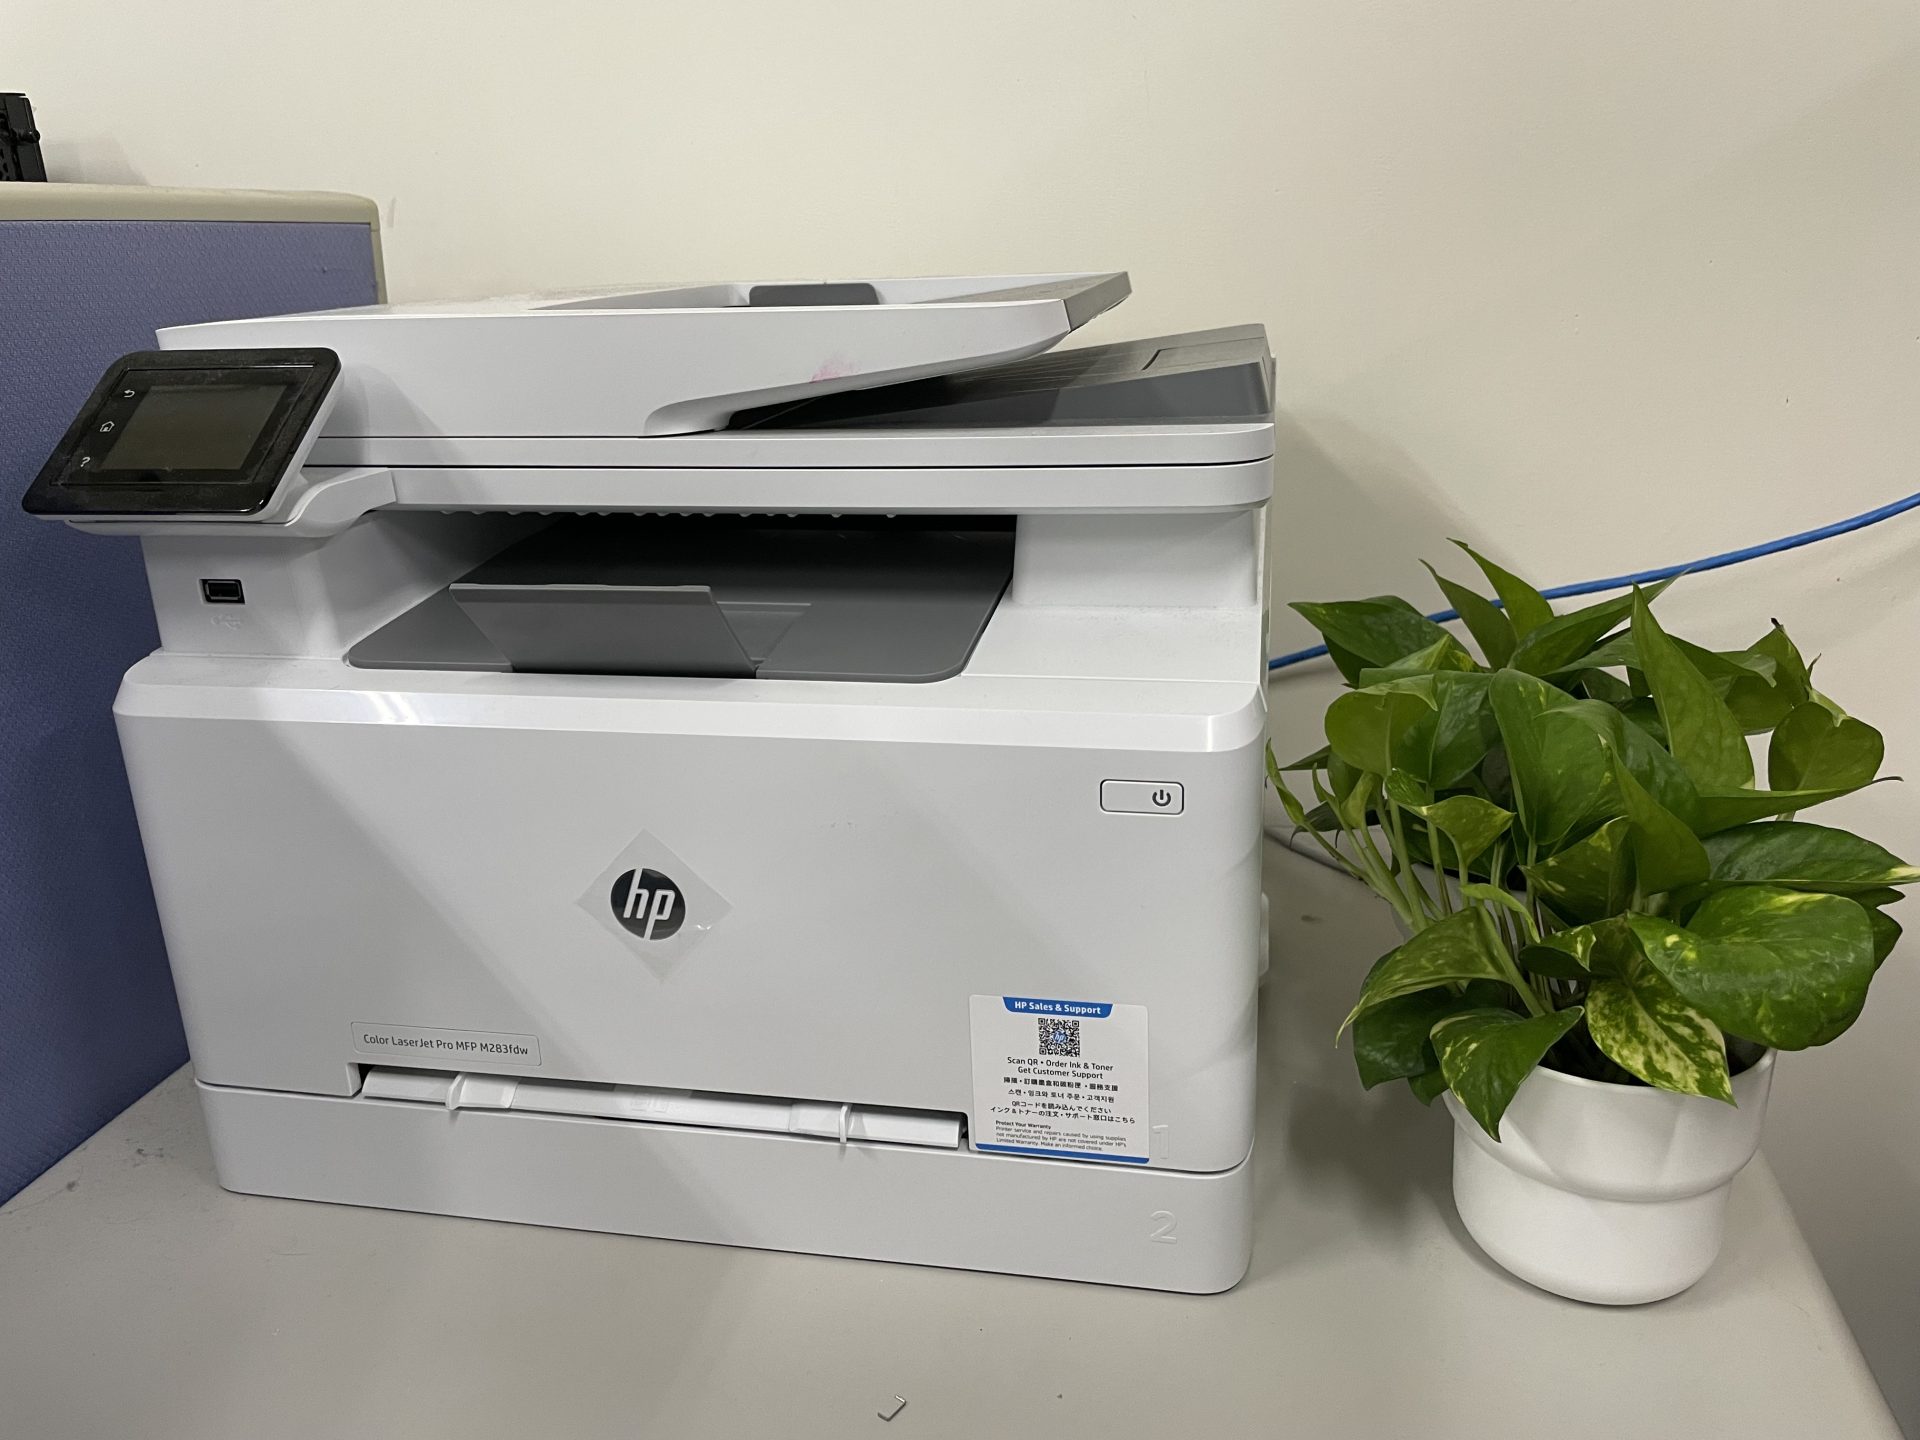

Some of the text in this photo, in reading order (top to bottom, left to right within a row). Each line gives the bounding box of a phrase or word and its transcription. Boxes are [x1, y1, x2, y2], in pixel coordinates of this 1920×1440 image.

[620, 868, 677, 939] hp
[1014, 1001, 1027, 1009] HP
[1029, 1002, 1053, 1011] Sales
[1064, 1004, 1101, 1014] Support
[363, 1034, 529, 1055] Color LaserJet Pro MFP M283fdw
[1007, 1057, 1026, 1065] Scan
[1027, 1058, 1038, 1066] QR
[1046, 1059, 1067, 1068] Order
[1069, 1061, 1081, 1069] Ink
[1092, 1063, 1113, 1071] Toner
[1018, 1066, 1103, 1079] Get Customer Support
[1028, 1122, 1051, 1130] Warranty
[1150, 1210, 1177, 1244] 2
